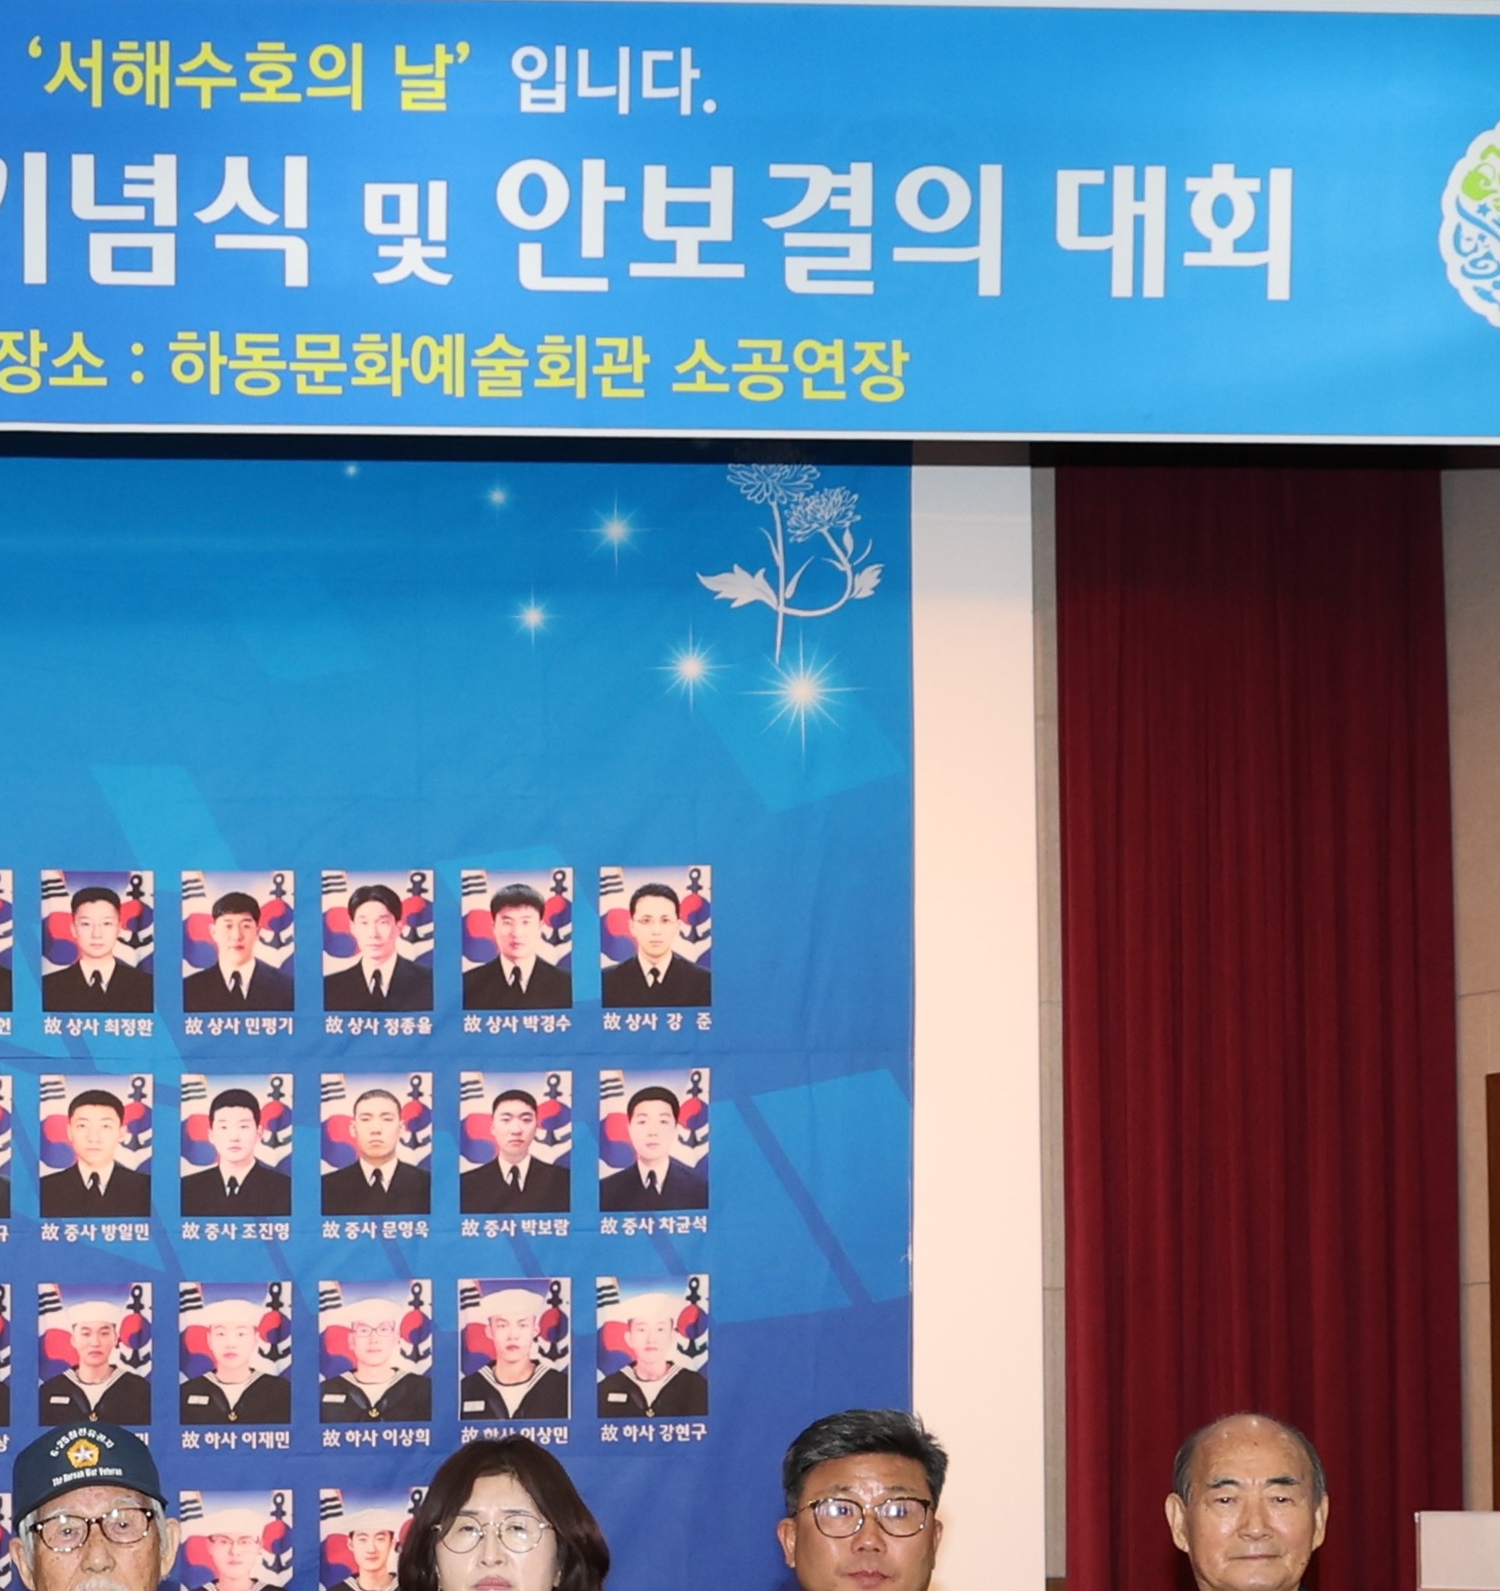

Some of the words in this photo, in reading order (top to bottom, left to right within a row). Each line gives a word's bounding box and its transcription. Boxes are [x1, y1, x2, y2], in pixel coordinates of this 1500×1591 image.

[511, 45, 717, 115] 입니다.
[363, 180, 453, 286] 및
[496, 158, 1003, 297] 안보결의
[1056, 163, 1293, 301] 대회
[131, 342, 144, 384] :
[168, 331, 651, 399] 하동문화예술회관
[672, 338, 910, 403] 소공연장
[43, 1016, 63, 1035] 故
[66, 1018, 100, 1037] 상사
[184, 1016, 204, 1036] 故
[207, 1017, 241, 1036] 상사
[463, 1014, 482, 1033] 故
[485, 1015, 519, 1034] 상사
[41, 1222, 60, 1241] 故
[63, 1223, 98, 1243] 중사
[461, 1218, 480, 1237] 故
[483, 1219, 518, 1239] 중사
[600, 1217, 618, 1235] 故
[621, 1217, 655, 1236] 중사
[181, 1430, 200, 1449] 故
[204, 1431, 238, 1450] 하사
[322, 1429, 341, 1447] 故
[345, 1429, 379, 1448] 하사
[601, 1423, 619, 1442] 故
[622, 1424, 654, 1443] 하사
